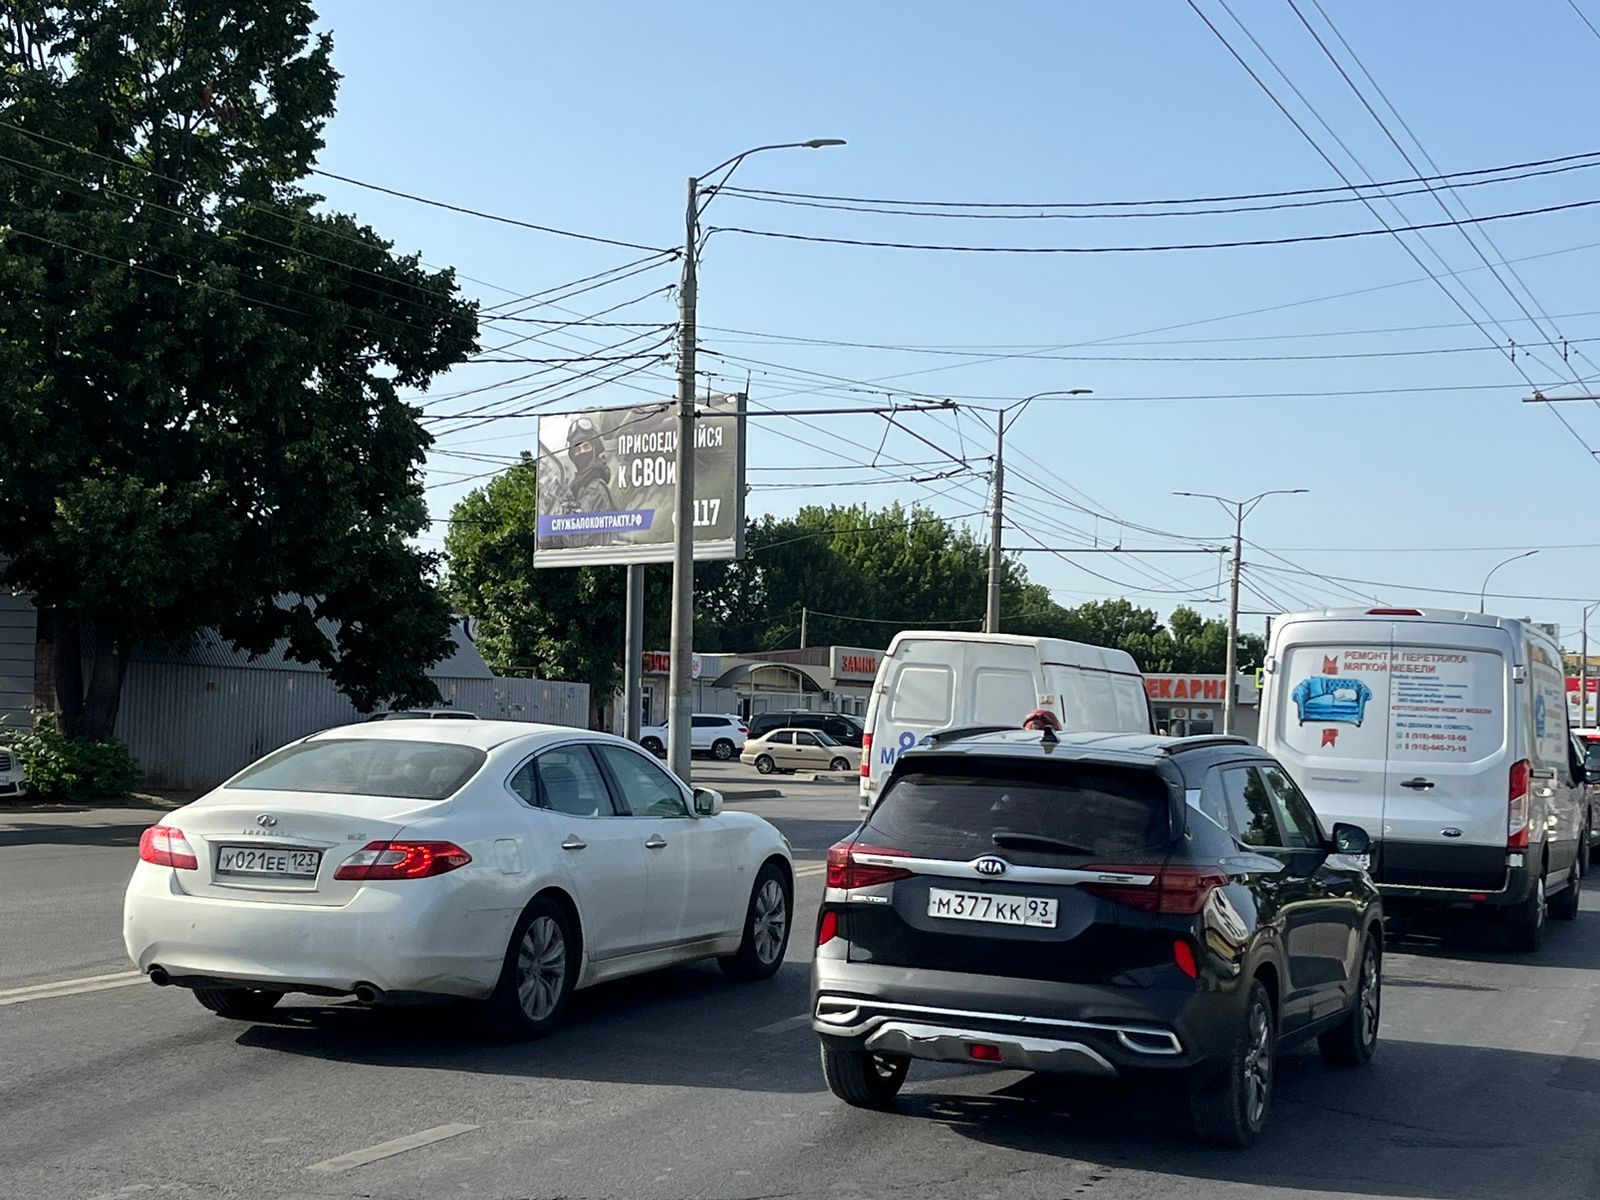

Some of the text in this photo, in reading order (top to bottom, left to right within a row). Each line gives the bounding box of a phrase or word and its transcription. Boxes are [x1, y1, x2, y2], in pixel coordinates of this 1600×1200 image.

[1344, 651, 1388, 661] РЕМОНТ
[1401, 652, 1468, 663] ПЕРЕТЯЖКА
[1344, 662, 1436, 674] МЯГКОЙ МЕБЕЛИ
[291, 853, 314, 867] 123
[978, 861, 1003, 873] KIA
[936, 894, 1049, 921] М377КК 93
